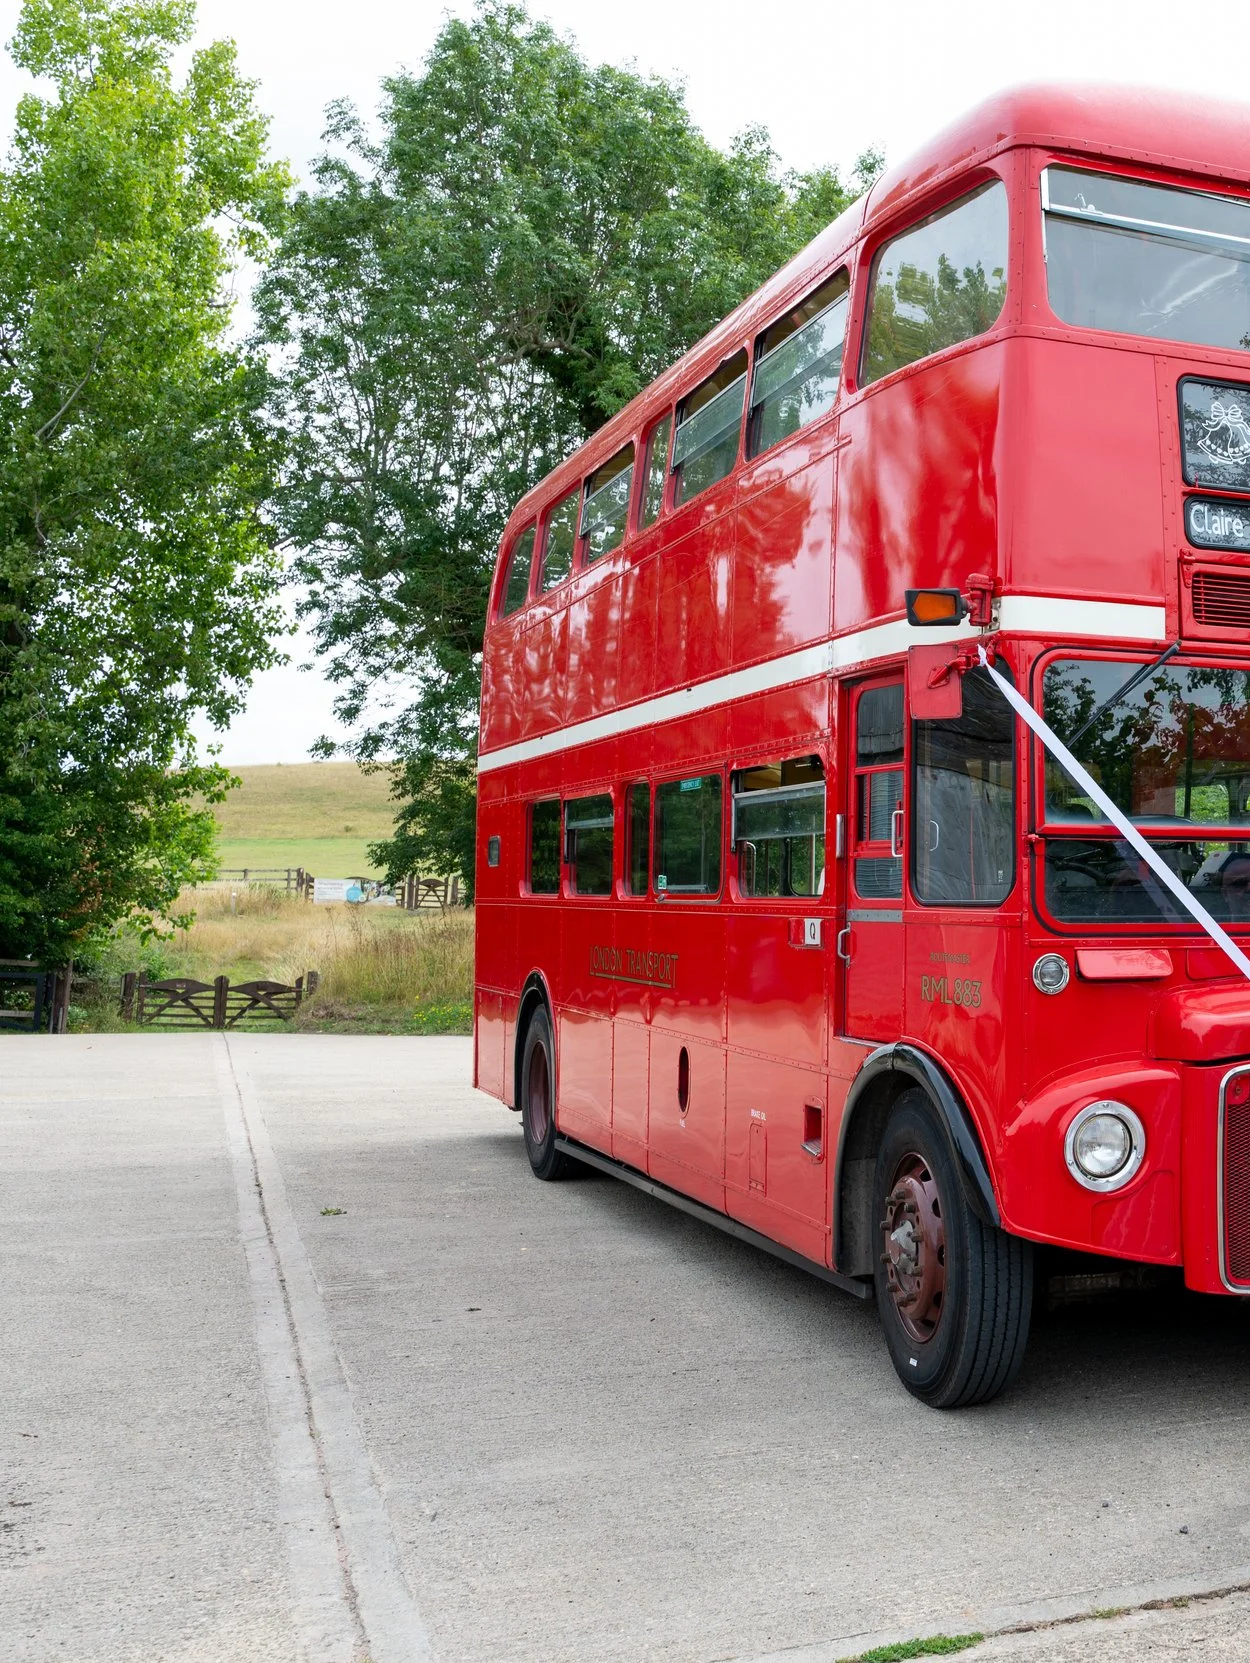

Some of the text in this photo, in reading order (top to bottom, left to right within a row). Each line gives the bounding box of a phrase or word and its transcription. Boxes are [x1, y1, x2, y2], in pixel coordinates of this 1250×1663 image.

[1190, 504, 1244, 538] Claire
[809, 921, 816, 940] Q
[589, 943, 679, 989] LONDON TRANSPORT
